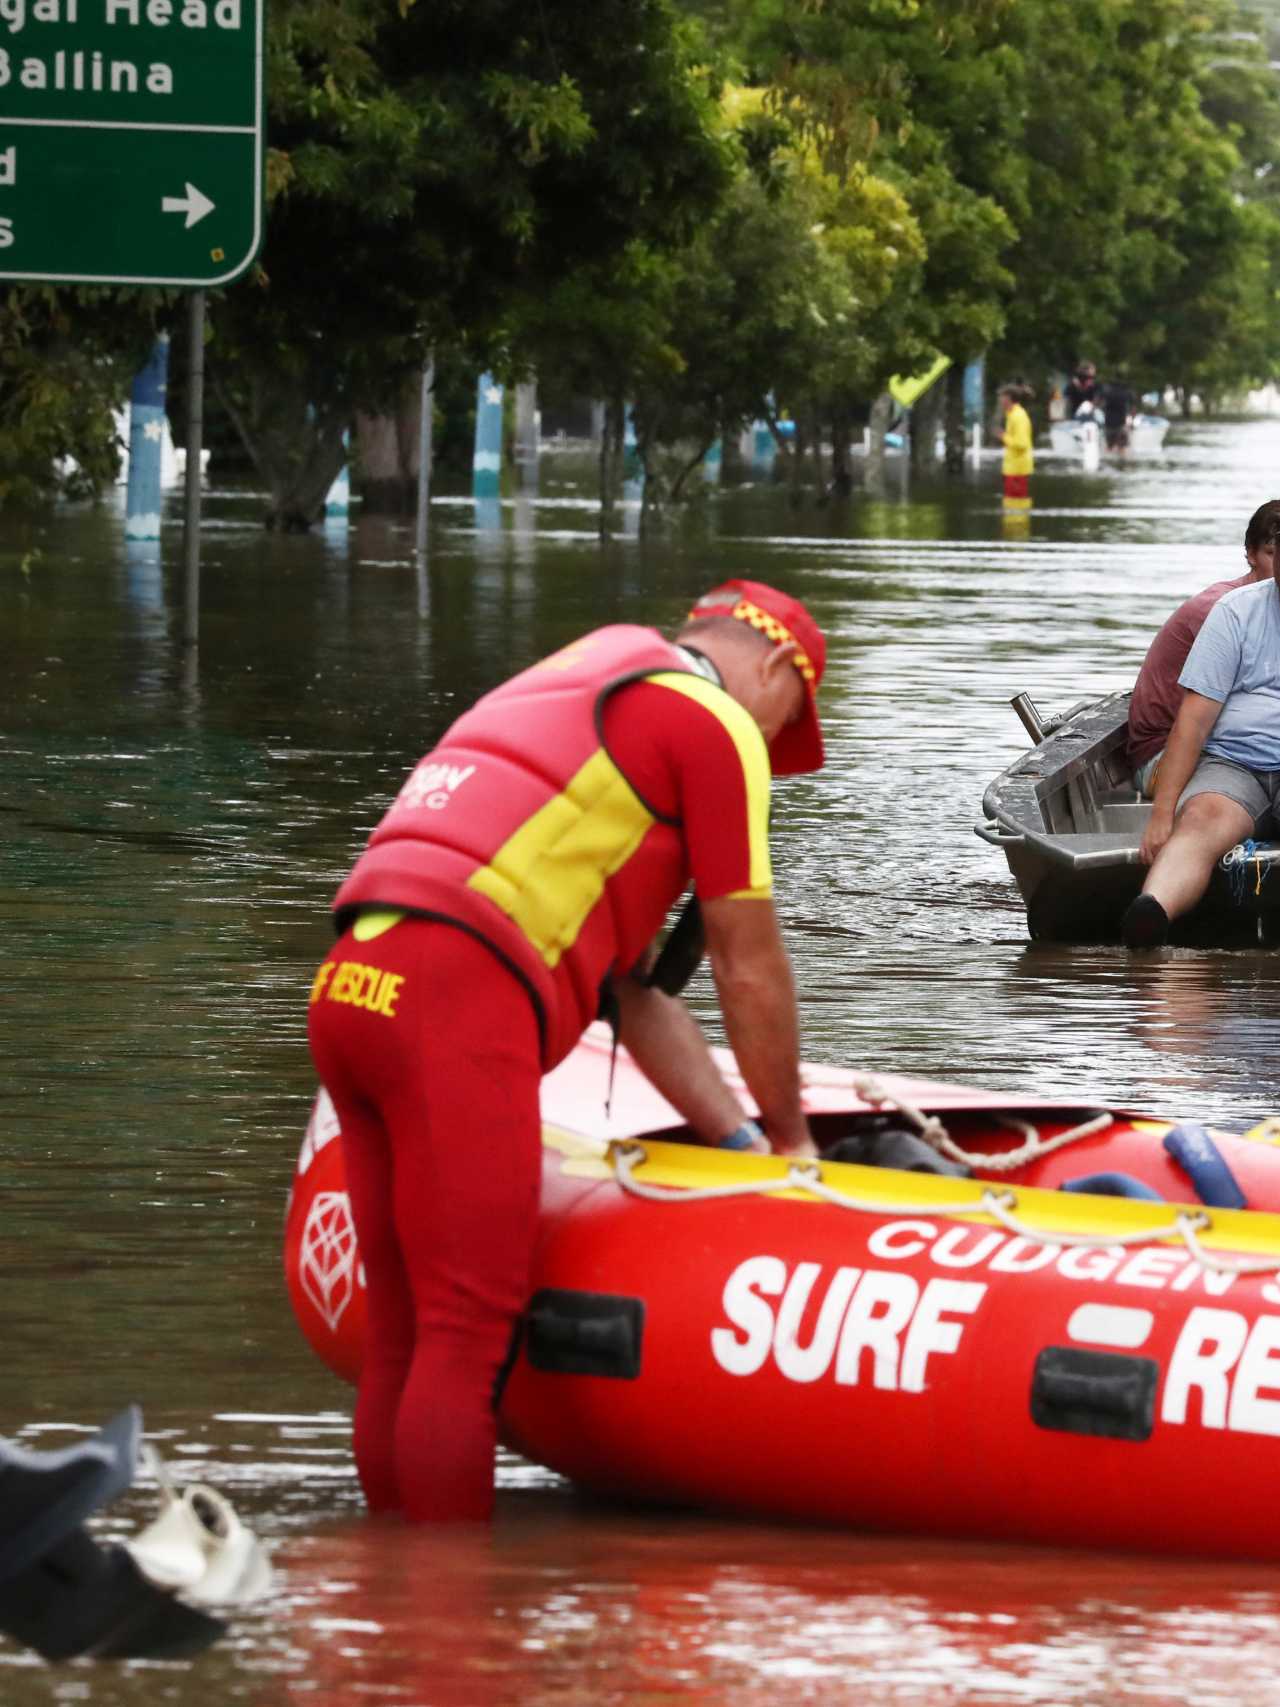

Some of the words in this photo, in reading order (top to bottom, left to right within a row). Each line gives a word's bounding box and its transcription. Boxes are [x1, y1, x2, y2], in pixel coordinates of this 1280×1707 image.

[106, 0, 241, 29] Head
[867, 1220, 1238, 1296] CUDGEN
[711, 1255, 988, 1394] SURF
